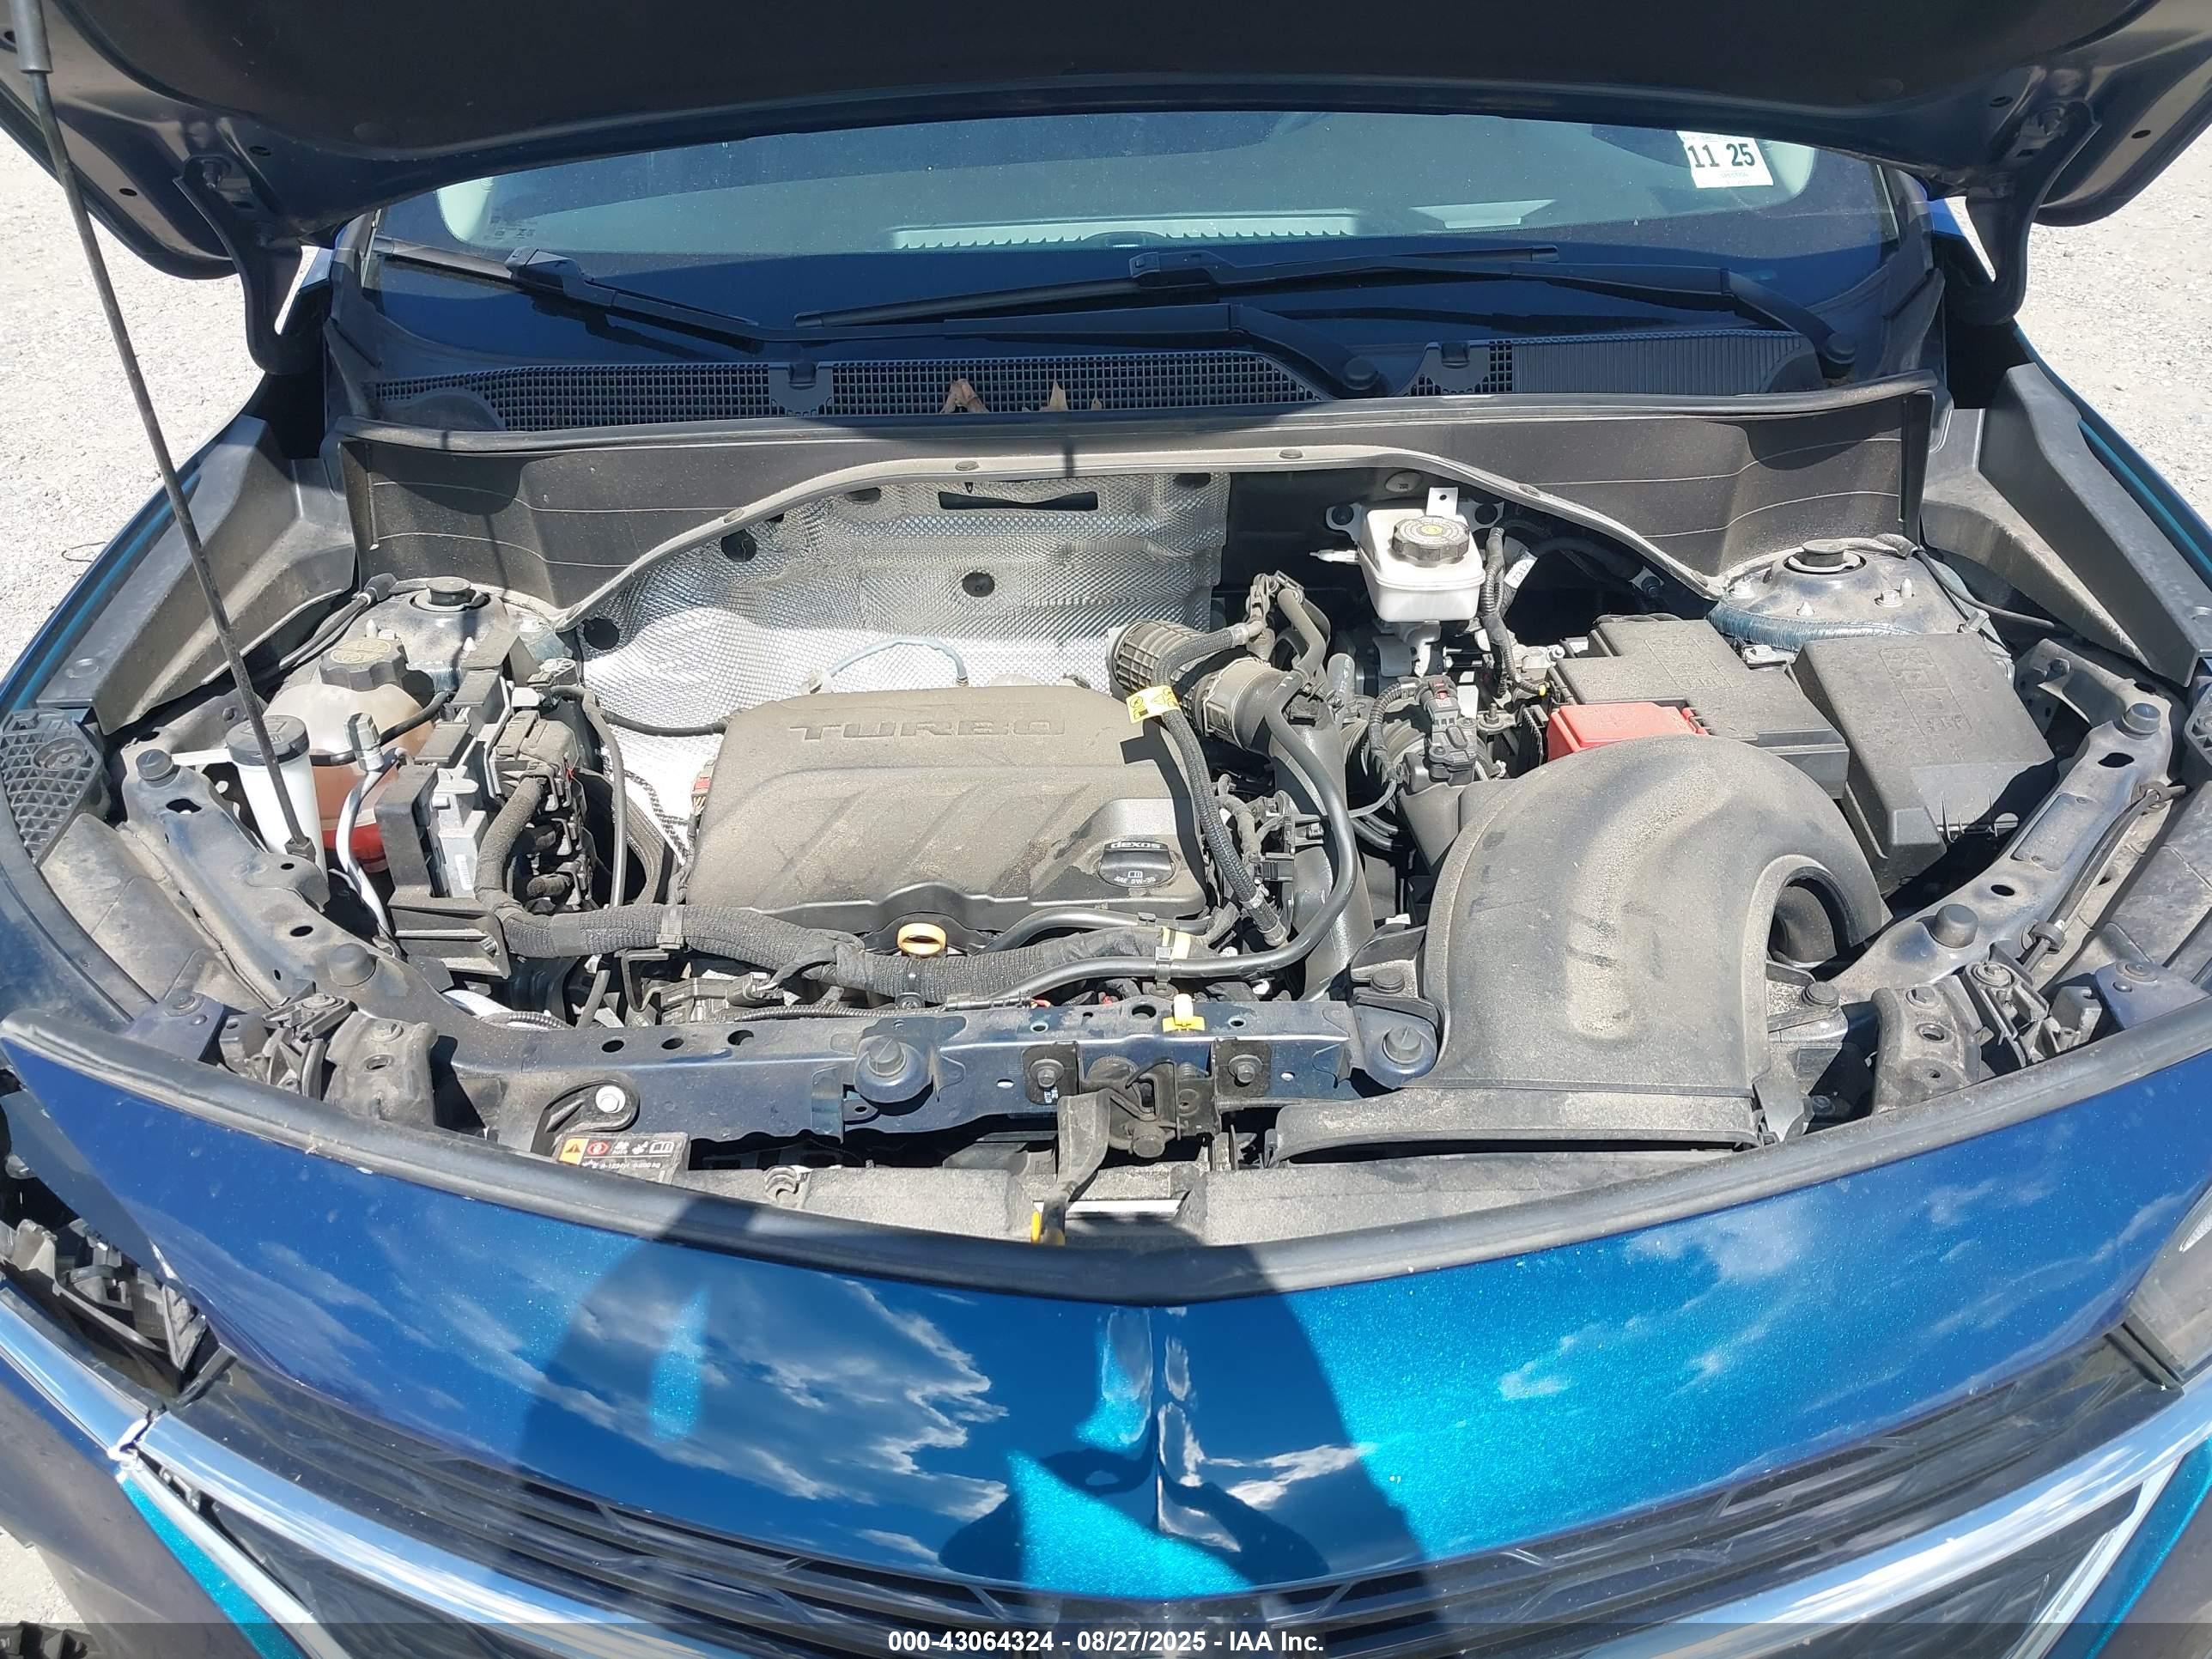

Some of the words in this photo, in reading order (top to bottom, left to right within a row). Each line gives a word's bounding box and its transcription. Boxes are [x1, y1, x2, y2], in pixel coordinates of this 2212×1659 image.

[1688, 144, 1720, 167] 11
[1726, 143, 1755, 167] 25
[789, 720, 1066, 741] TURBO
[1110, 841, 1161, 849] dexos
